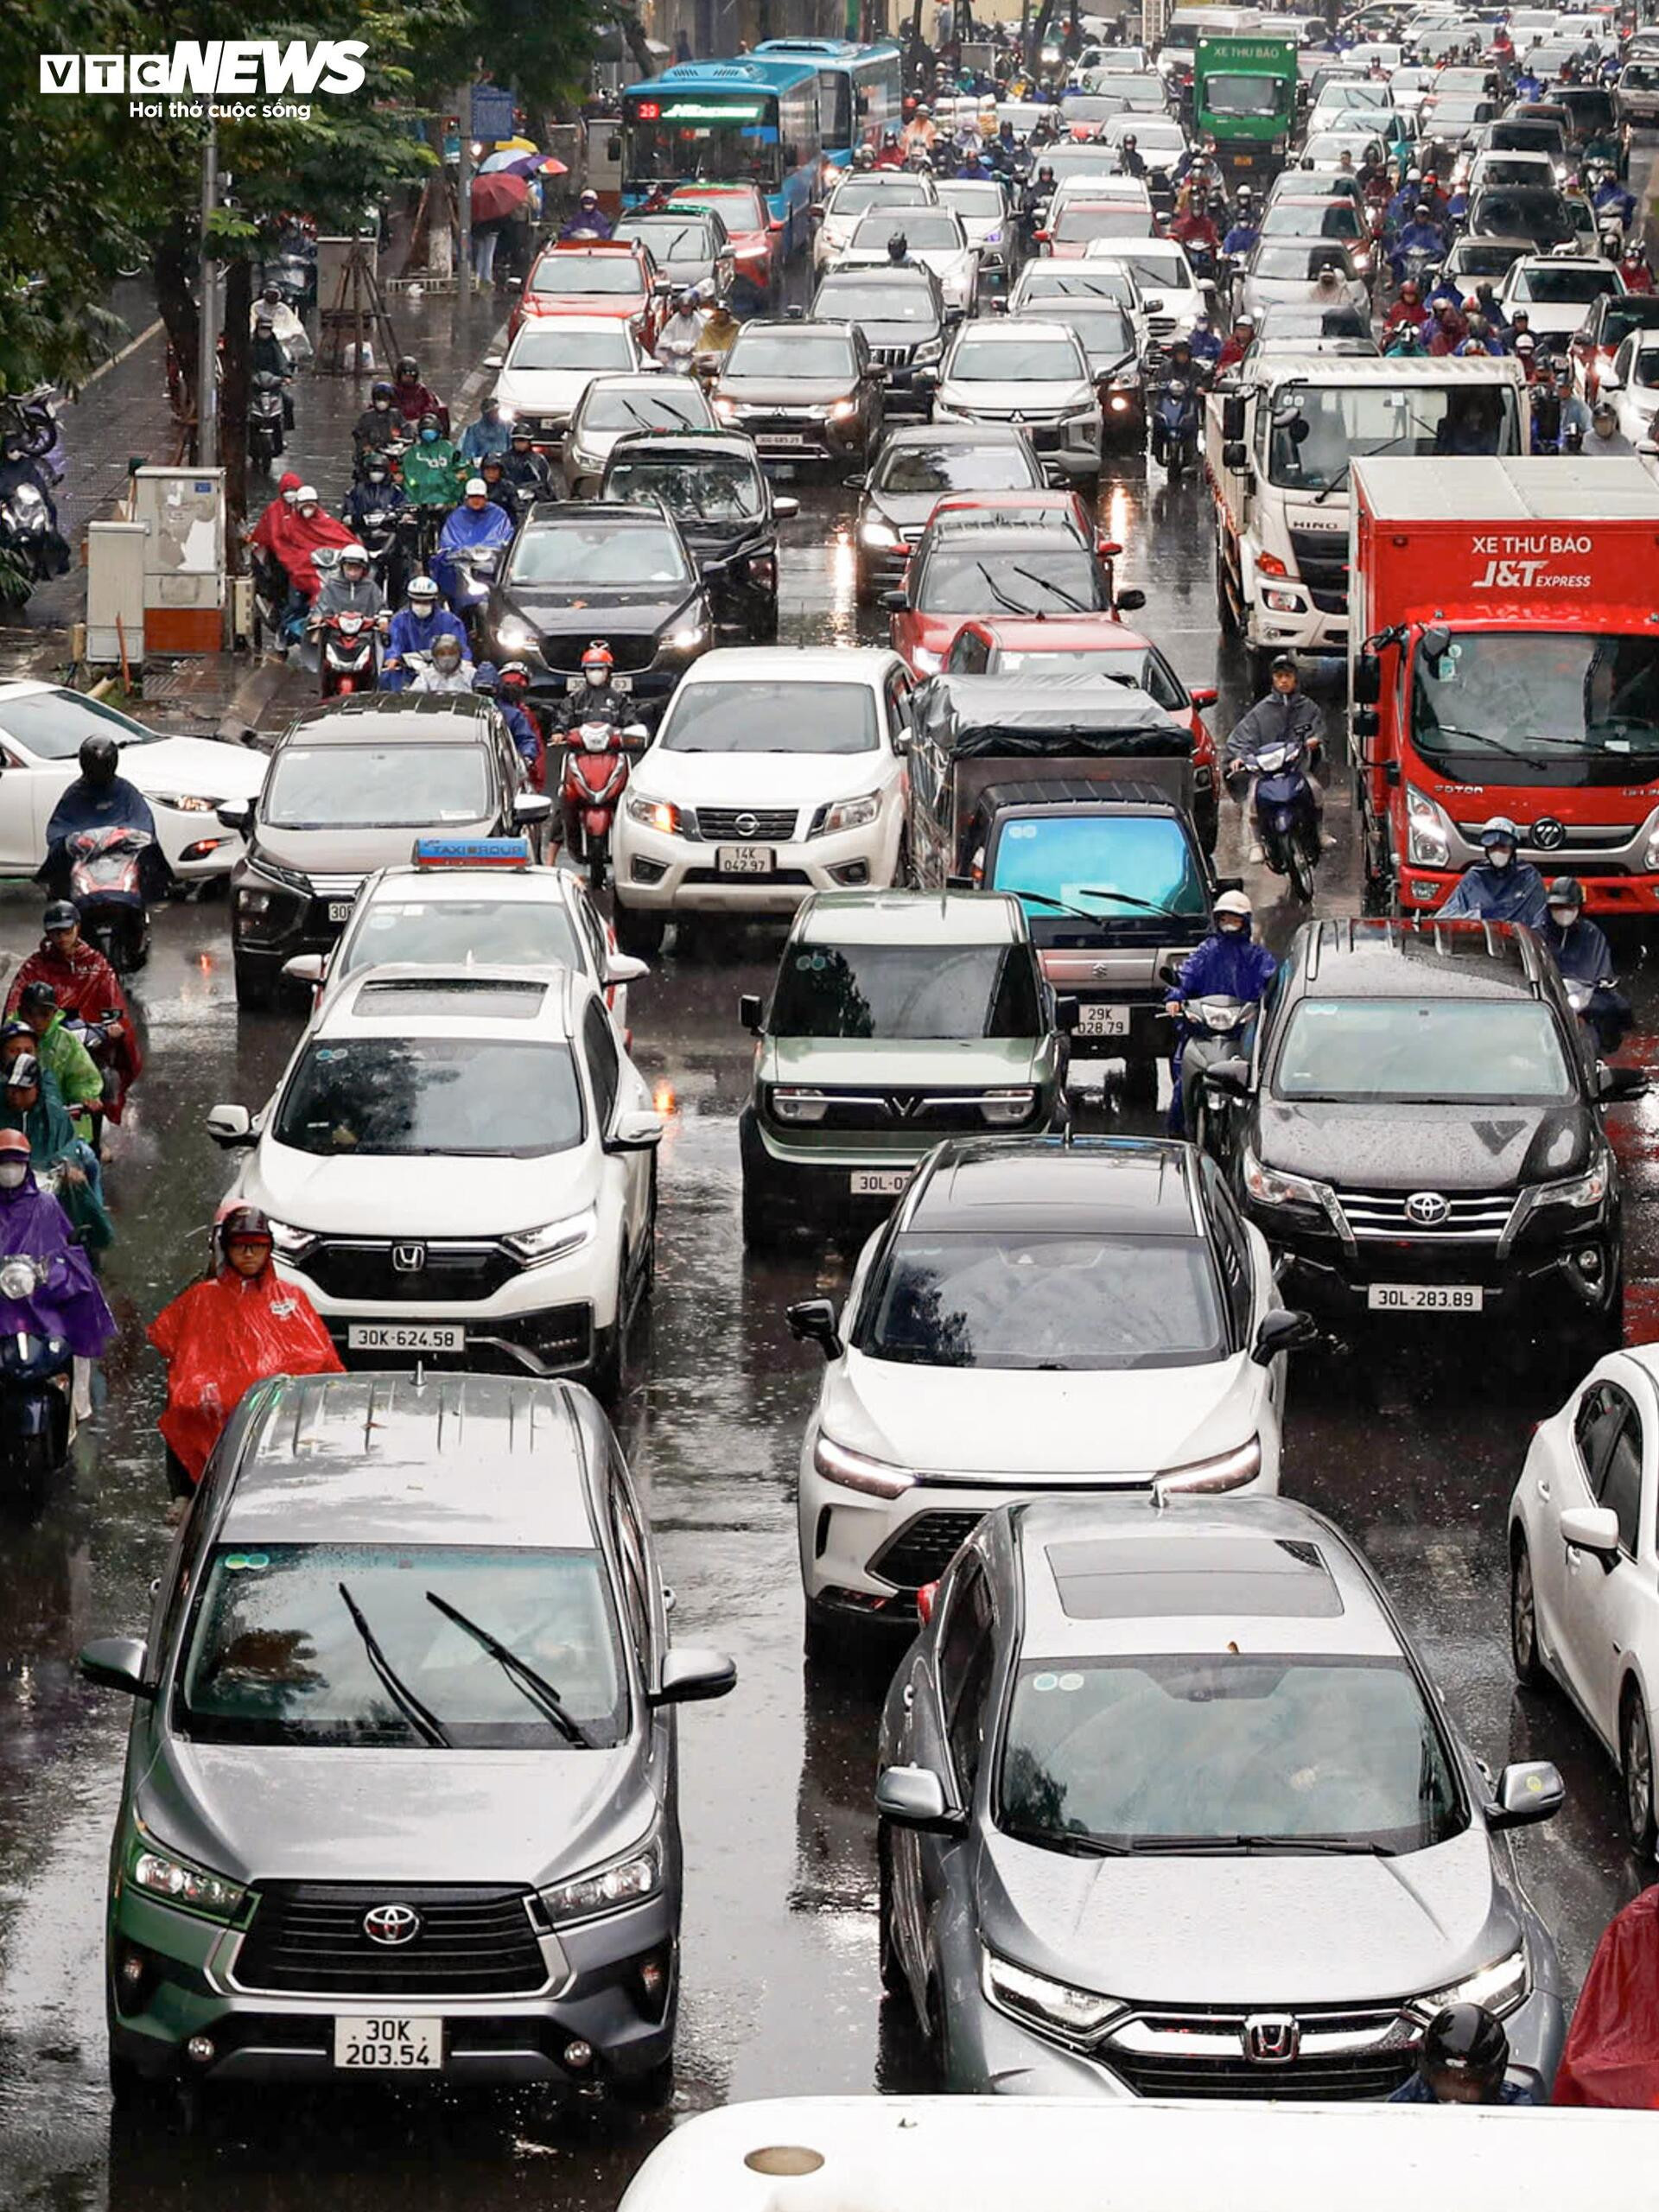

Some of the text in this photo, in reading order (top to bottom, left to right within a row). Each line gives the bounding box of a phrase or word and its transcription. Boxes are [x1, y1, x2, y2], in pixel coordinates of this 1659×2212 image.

[1471, 537, 1498, 553] XE
[1502, 534, 1547, 553] THƯ
[1471, 560, 1591, 587] J&T EXPRESS
[735, 848, 755, 859] 14K
[1089, 1008, 1112, 1020] 29K
[1378, 1290, 1473, 1307] 30L-283.89
[358, 1330, 454, 1347] 30K-624.58
[365, 2019, 410, 2041] 30K
[346, 2044, 430, 2066] 203.54
